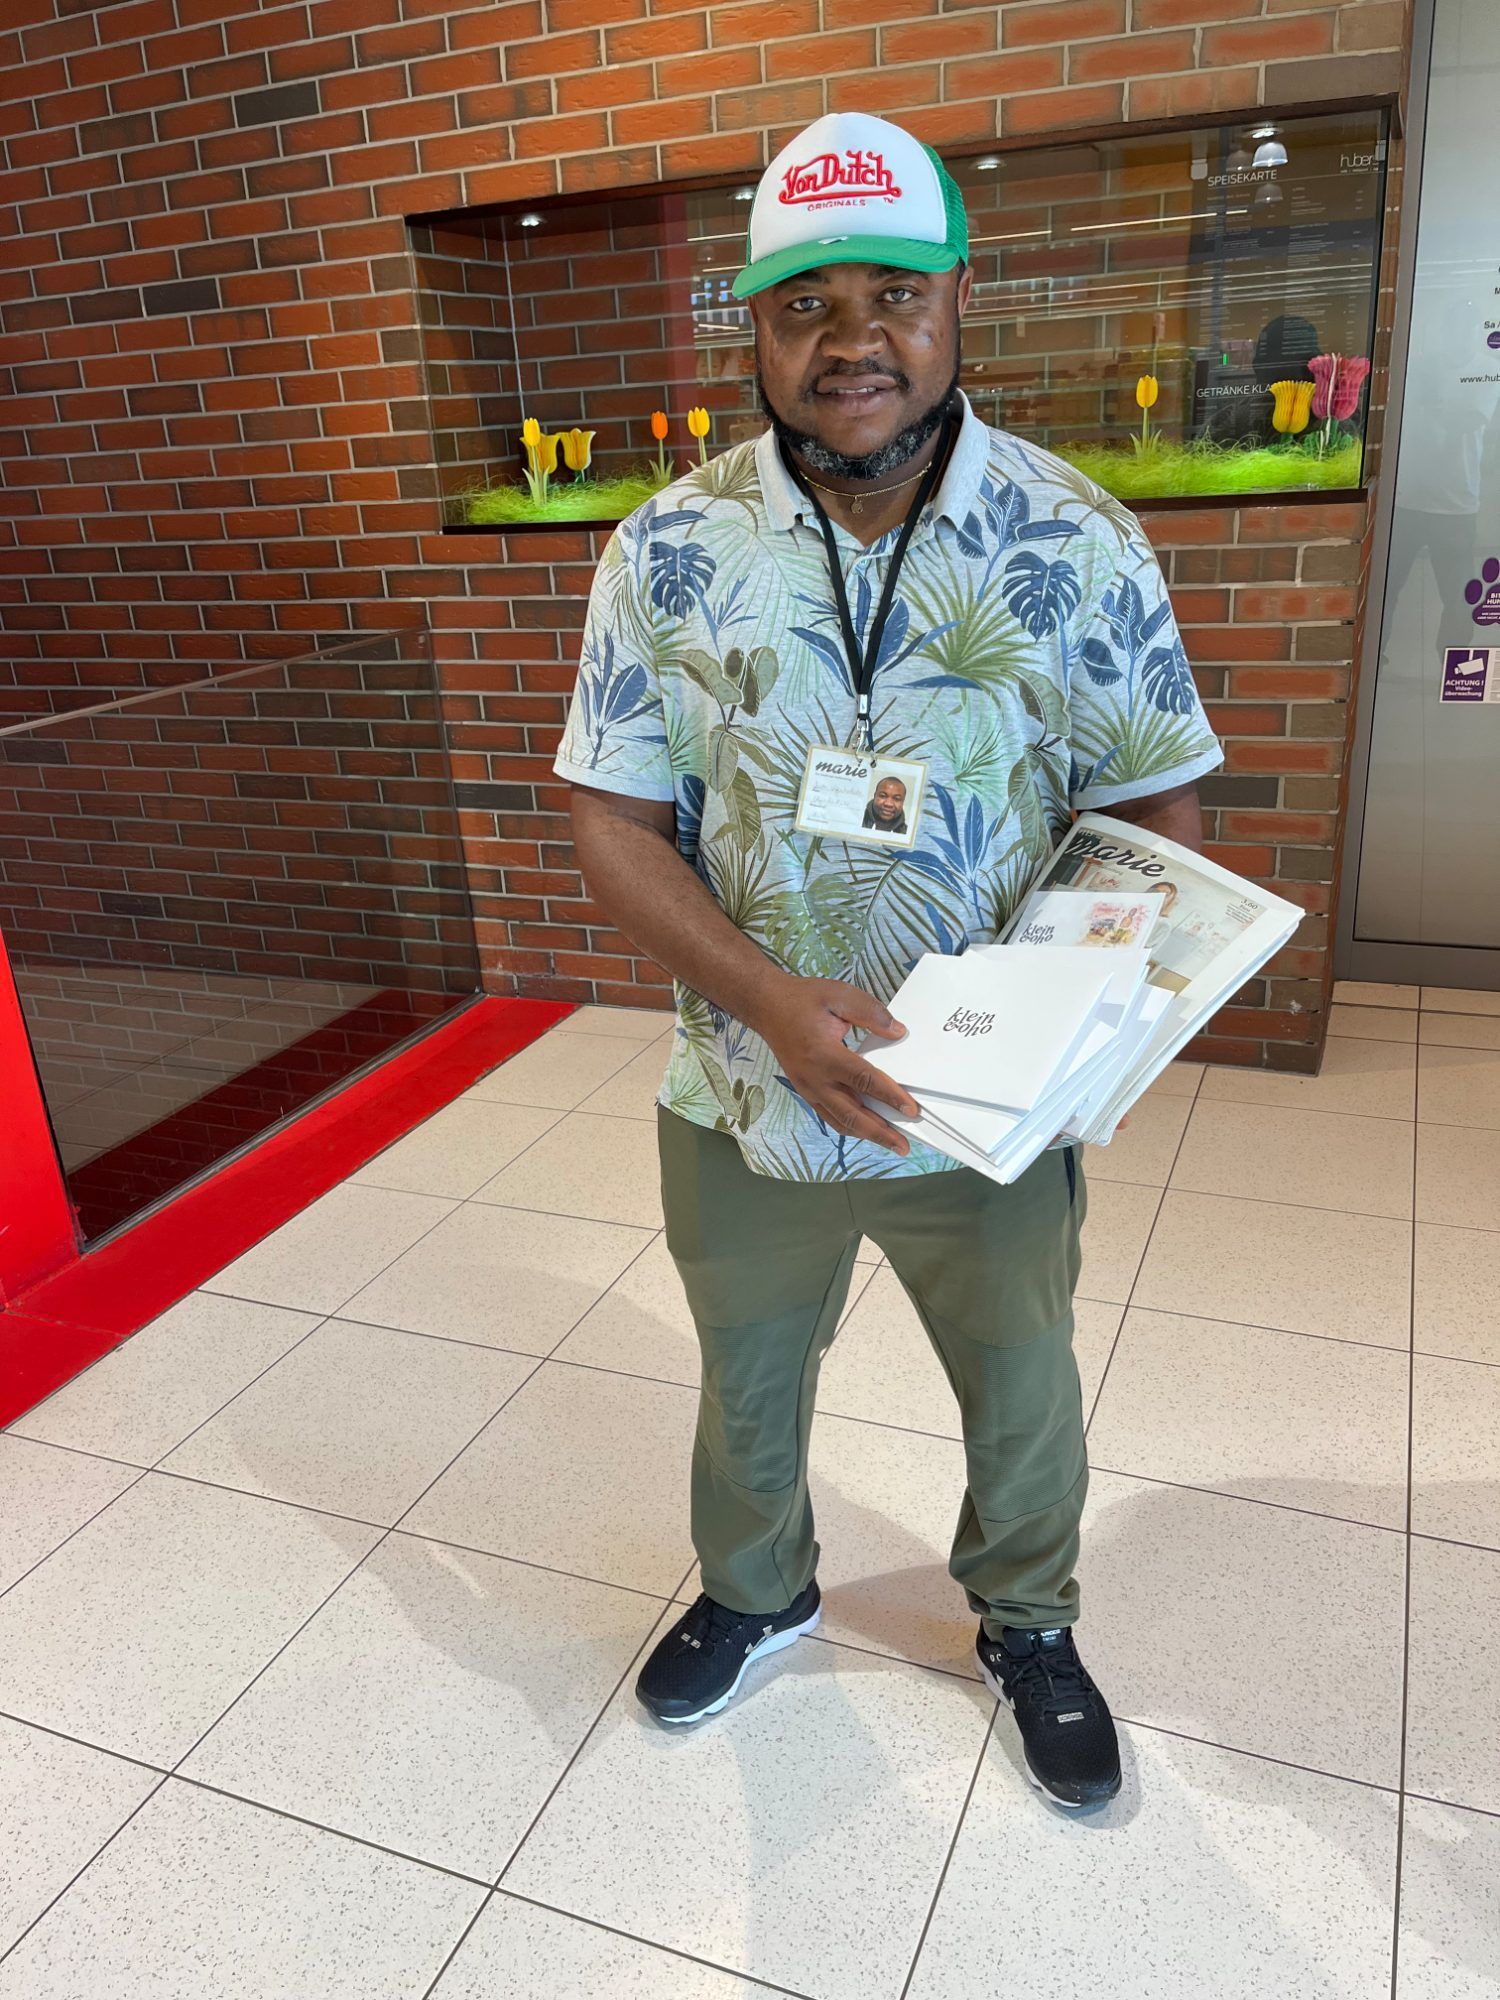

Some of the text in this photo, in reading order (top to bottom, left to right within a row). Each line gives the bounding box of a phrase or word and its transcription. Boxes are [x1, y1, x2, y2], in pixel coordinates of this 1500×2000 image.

[780, 150, 897, 199] Von Dutch
[1207, 169, 1278, 187] SPEISEKARTE
[807, 199, 866, 212] ORIGINALS
[1483, 320, 1496, 329] Sa
[1196, 384, 1250, 398] GETRÄNKE
[815, 761, 868, 778] marie
[1063, 837, 1166, 878] marie
[1022, 922, 1055, 936] klein
[946, 1006, 996, 1025] klein
